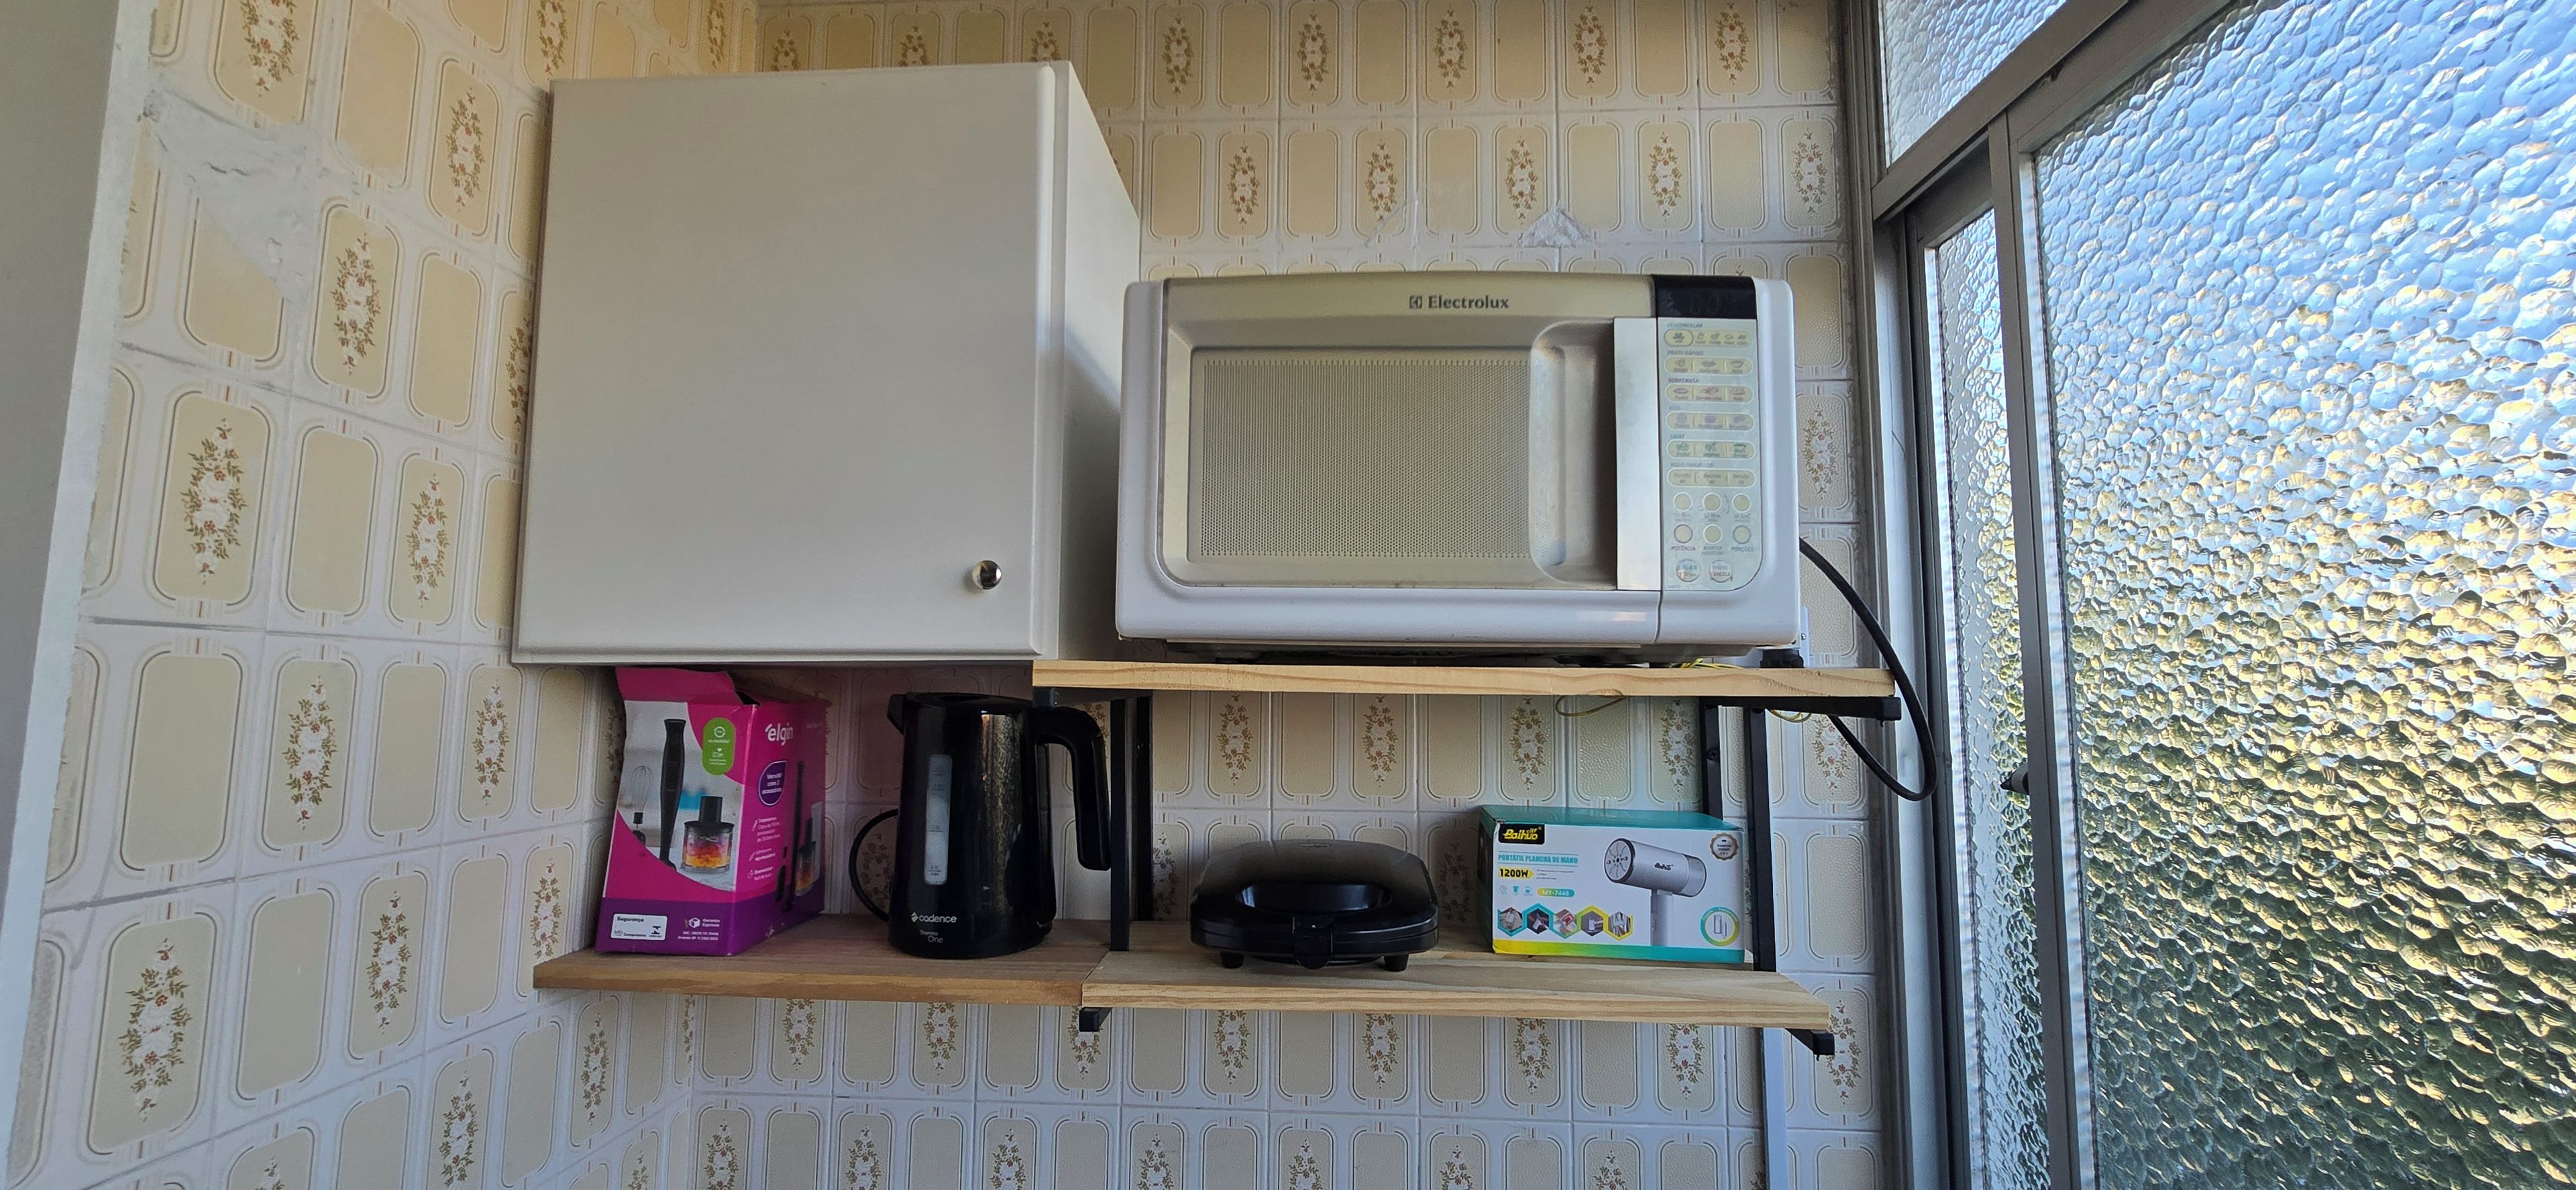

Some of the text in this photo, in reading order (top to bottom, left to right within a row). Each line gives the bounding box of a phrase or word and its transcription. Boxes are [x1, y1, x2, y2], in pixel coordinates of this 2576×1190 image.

[1428, 294, 1509, 309] Electrolux
[766, 722, 794, 746] elgin
[1503, 829, 1538, 841] Baihuo
[1499, 869, 1529, 878] 1200W
[918, 914, 957, 923] cadence
[928, 935, 944, 943] One
